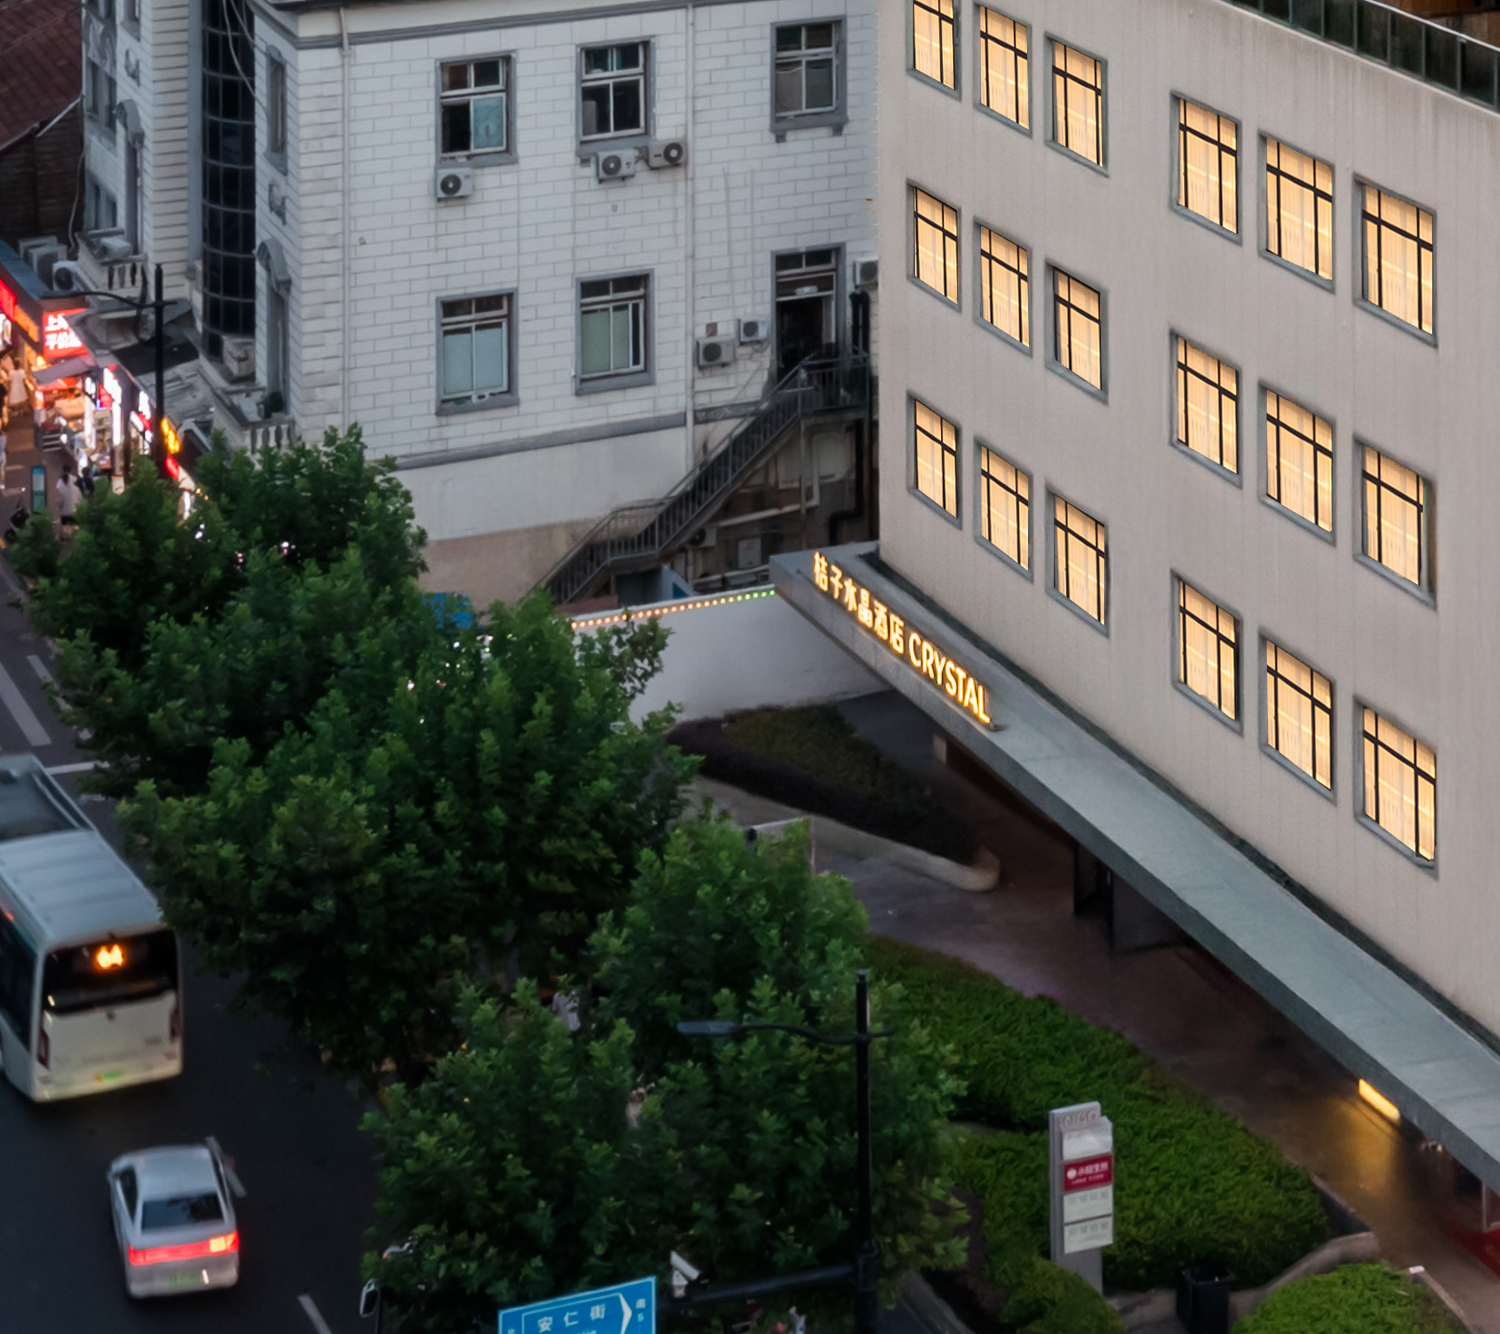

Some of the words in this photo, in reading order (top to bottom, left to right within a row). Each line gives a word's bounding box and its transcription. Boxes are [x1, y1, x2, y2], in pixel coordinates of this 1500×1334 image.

[812, 551, 905, 655] 桔子水晶酒店
[908, 632, 992, 725] CRYSTAL
[537, 1304, 606, 1333] 安仁街
